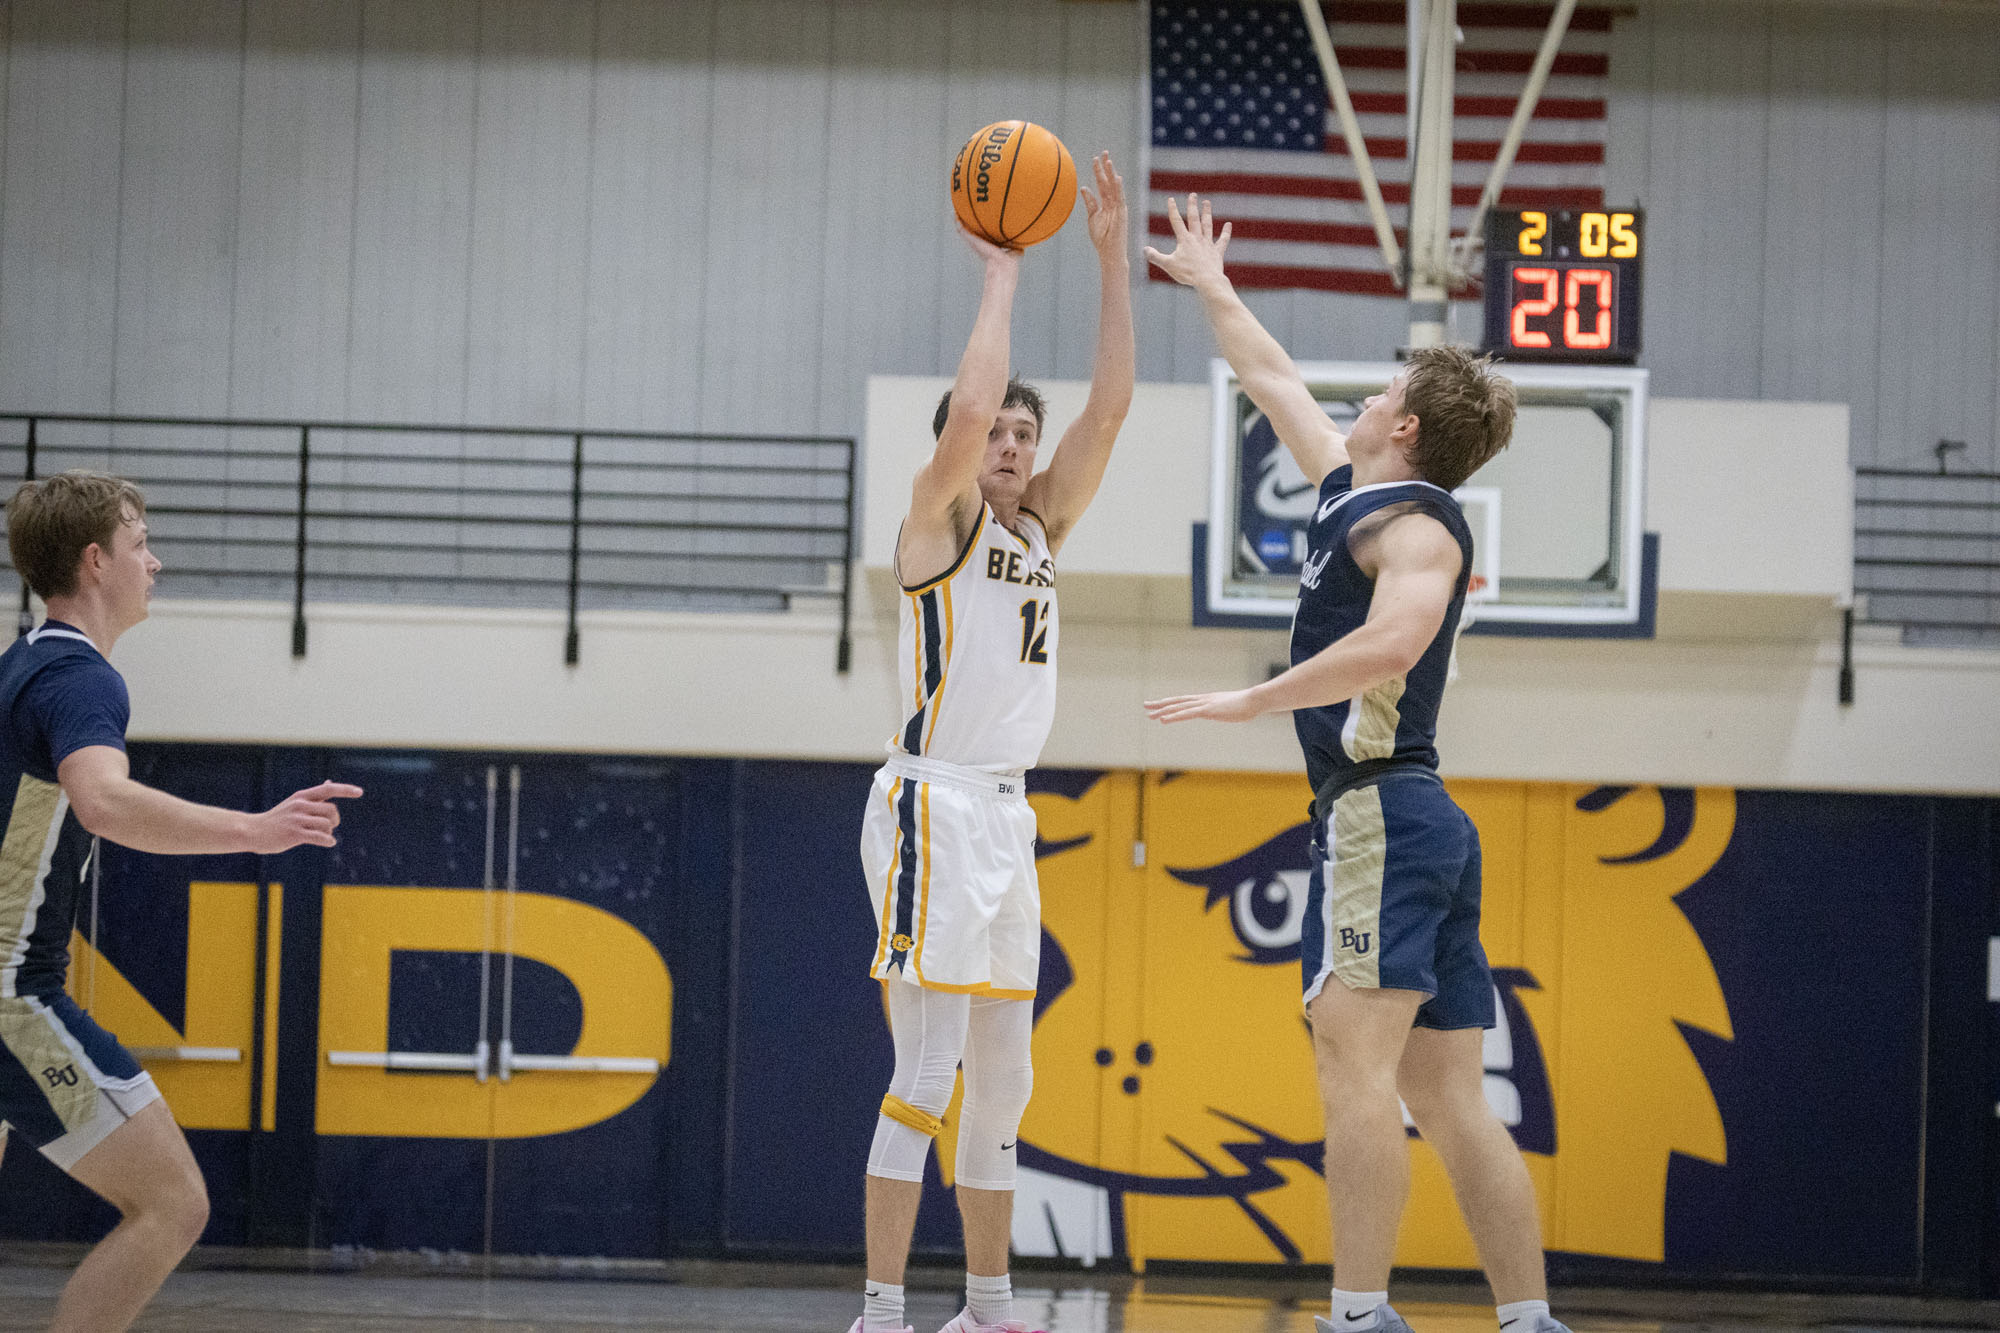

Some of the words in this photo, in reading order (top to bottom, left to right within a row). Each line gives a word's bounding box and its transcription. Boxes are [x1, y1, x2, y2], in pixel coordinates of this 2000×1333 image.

[977, 127, 1014, 202] Wilson
[1510, 267, 1612, 349] 20
[1020, 598, 1050, 665] 12
[998, 783, 1015, 794] BVU
[1339, 927, 1371, 954] BU
[42, 1064, 79, 1087] BU
